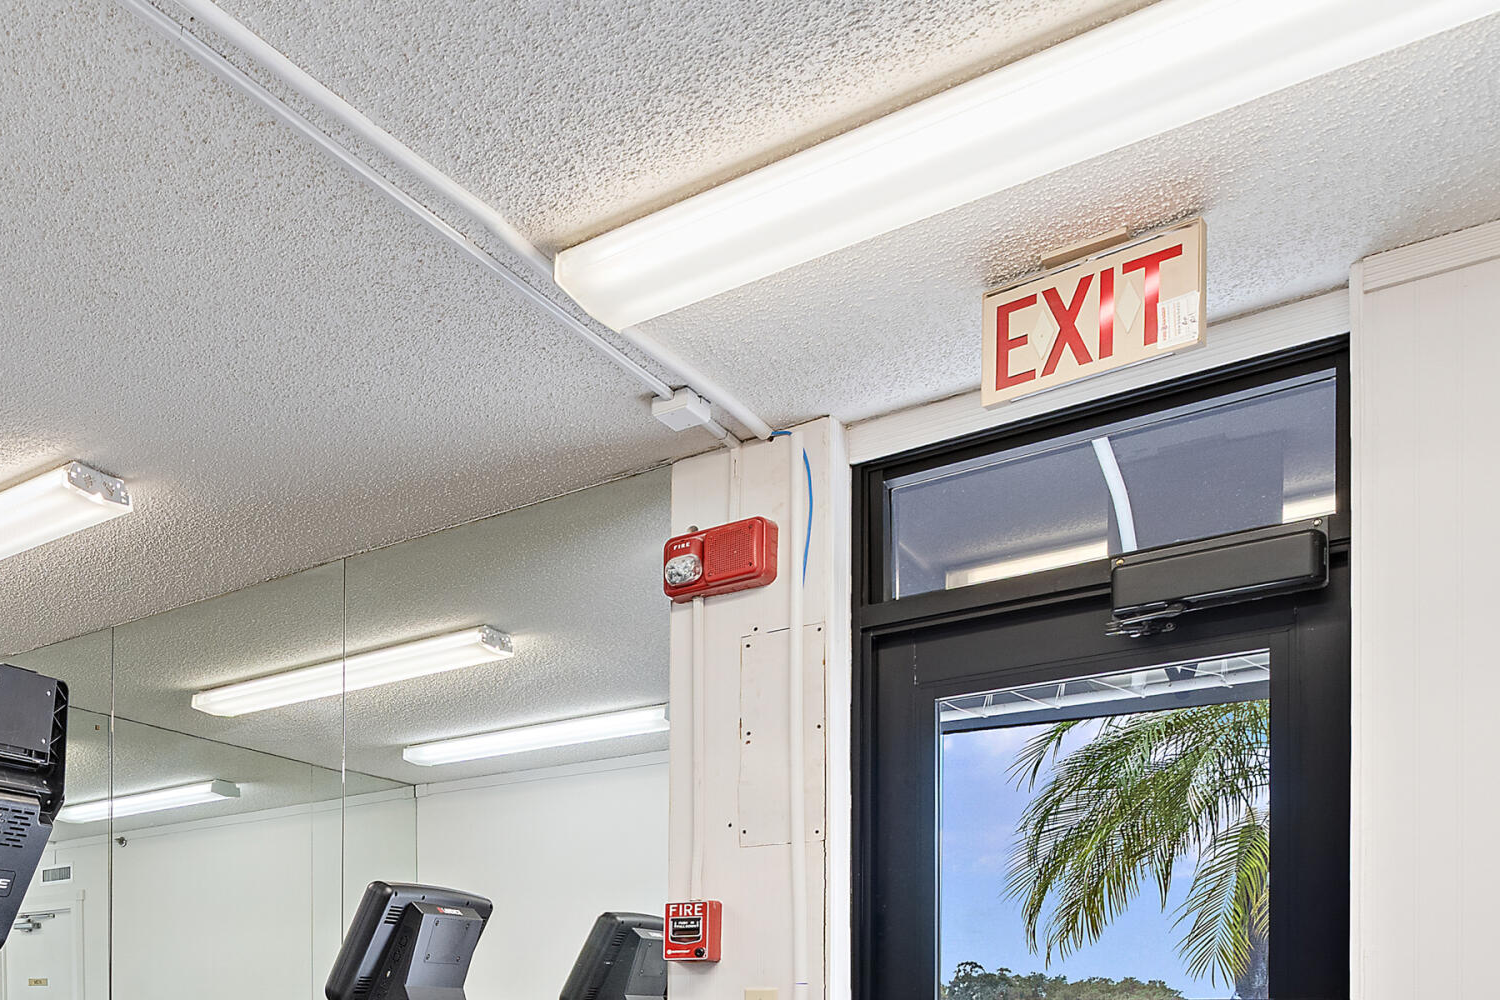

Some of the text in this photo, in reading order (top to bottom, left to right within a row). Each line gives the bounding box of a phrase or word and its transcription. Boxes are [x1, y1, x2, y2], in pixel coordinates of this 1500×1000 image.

[995, 243, 1183, 392] EXIT
[673, 541, 691, 551] FIRE
[669, 903, 704, 917] FIRE
